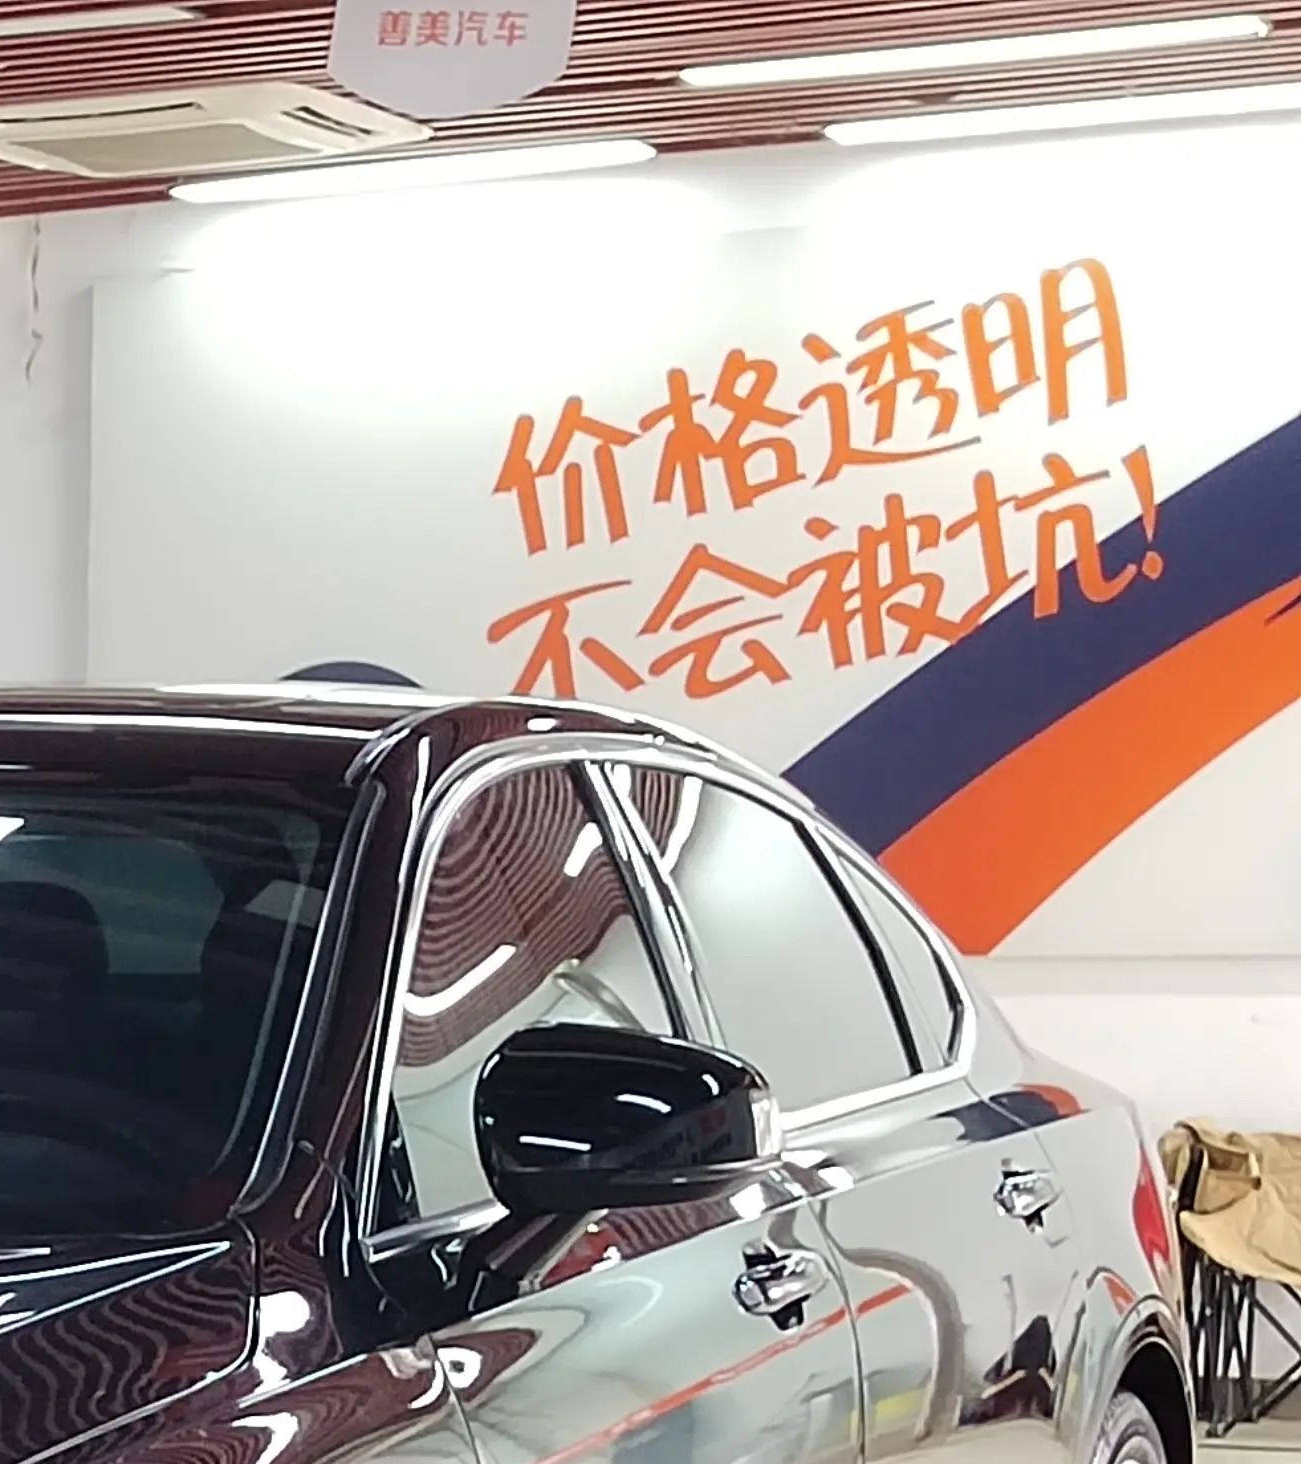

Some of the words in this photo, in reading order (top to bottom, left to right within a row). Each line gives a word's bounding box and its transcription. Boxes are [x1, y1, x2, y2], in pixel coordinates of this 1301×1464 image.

[377, 9, 529, 47] 善美汽车
[491, 257, 1128, 556] 价格透明
